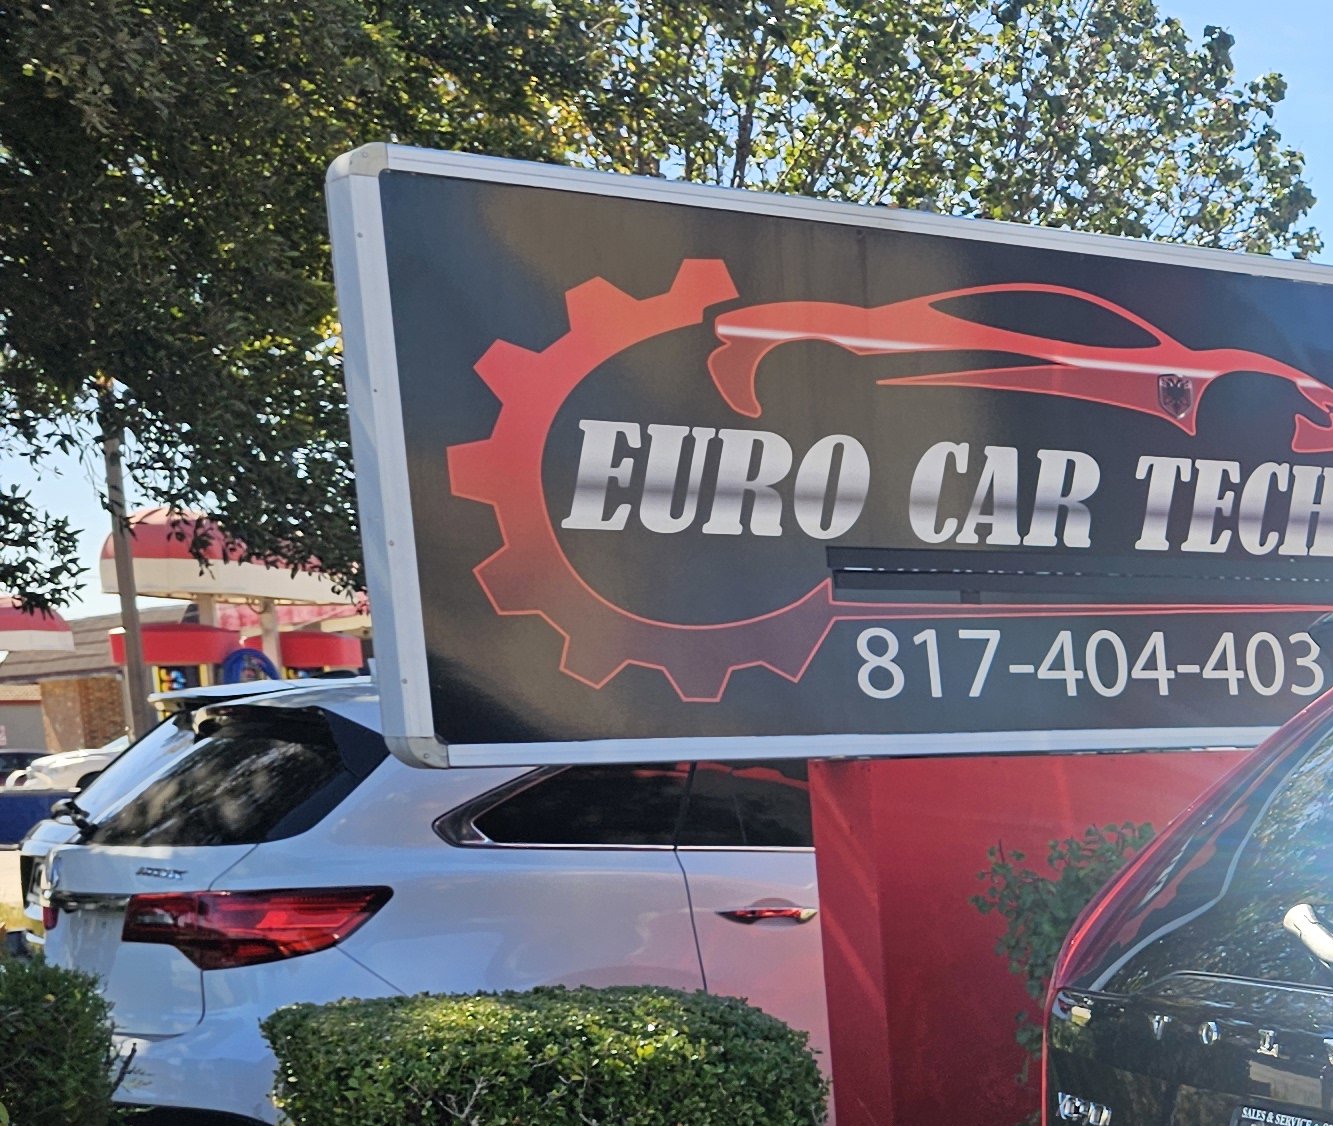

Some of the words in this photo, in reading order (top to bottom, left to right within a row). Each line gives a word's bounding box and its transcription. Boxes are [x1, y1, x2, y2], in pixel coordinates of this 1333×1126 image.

[561, 419, 871, 540] EURO
[908, 441, 1101, 548] CAR
[856, 626, 1326, 699] 817-404-403
[1242, 1106, 1267, 1122] SALES
[1267, 1112, 1274, 1123] &
